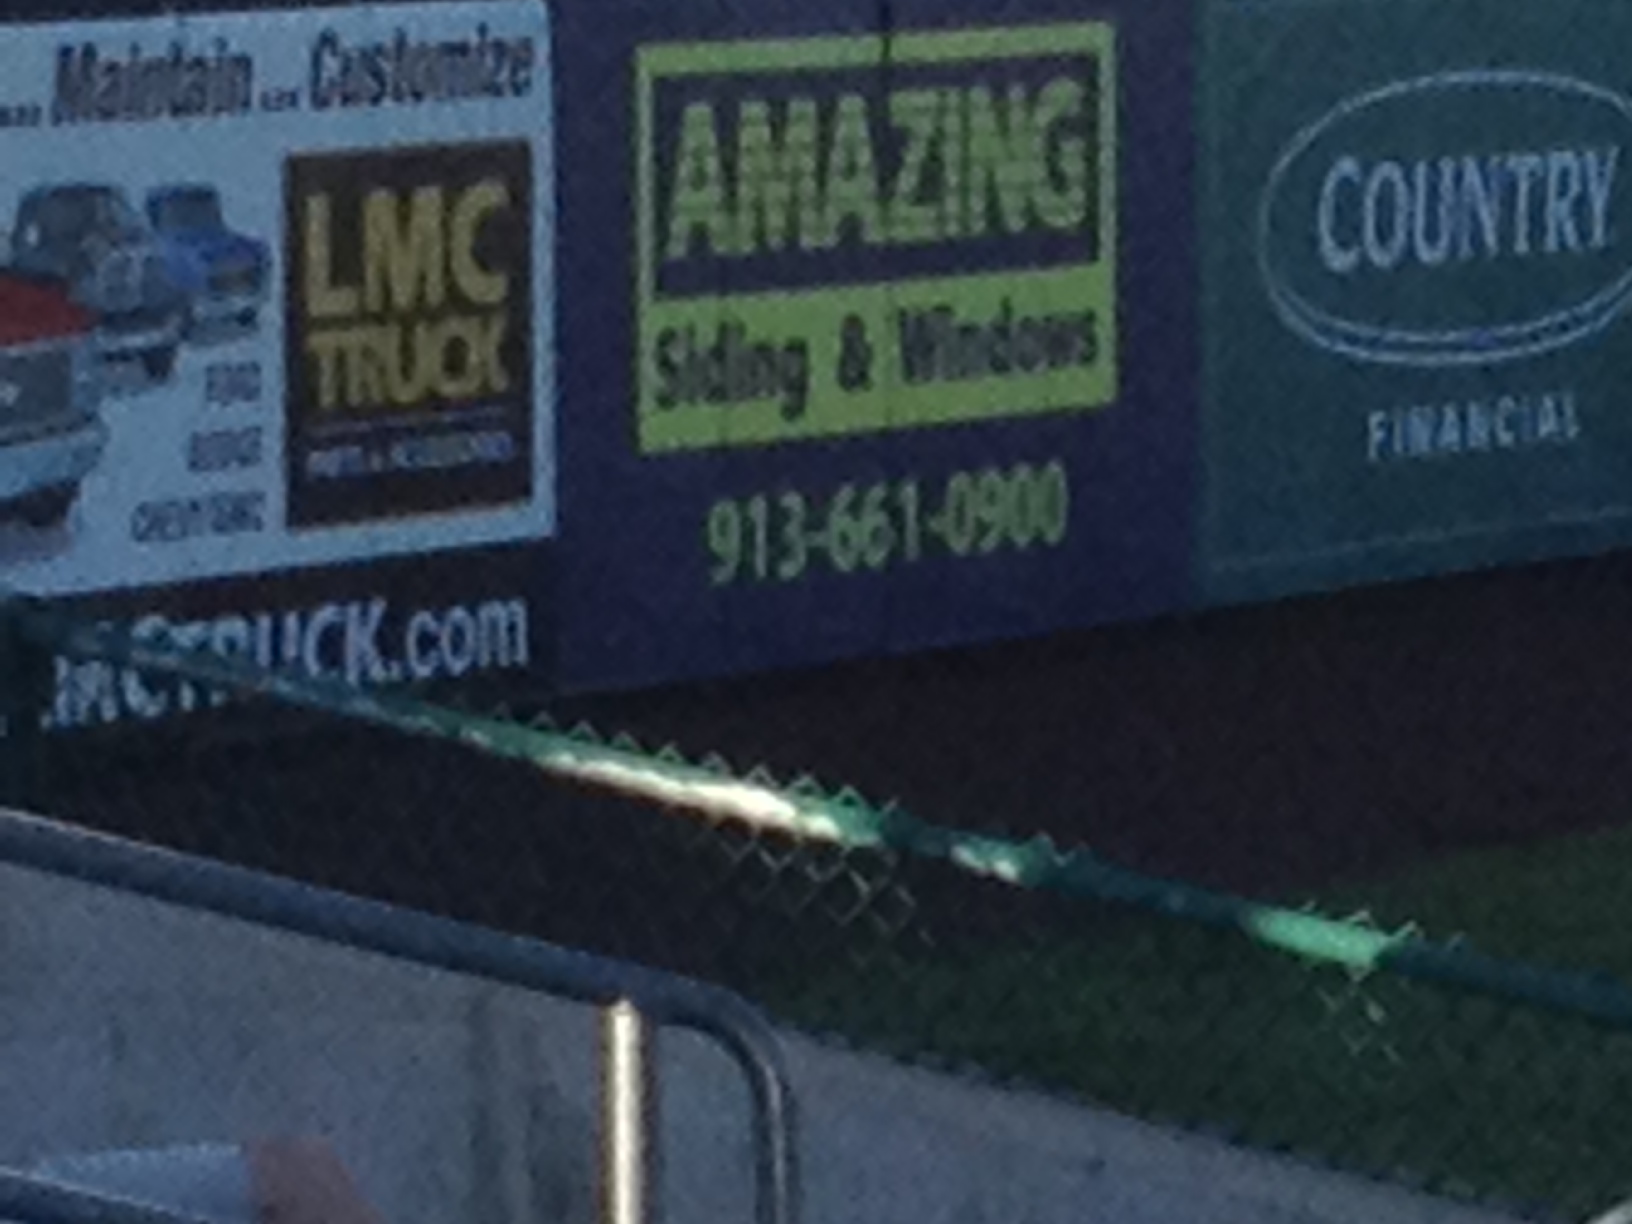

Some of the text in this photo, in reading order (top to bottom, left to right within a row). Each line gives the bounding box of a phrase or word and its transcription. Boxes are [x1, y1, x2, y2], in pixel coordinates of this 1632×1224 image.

[50, 22, 535, 127] Maintain Customize
[667, 77, 1086, 258] AMAZING
[1318, 145, 1620, 271] COUNTRY
[306, 177, 510, 318] LMC
[306, 307, 510, 410] TRUCK
[656, 298, 1097, 422] Siding & Windows
[1368, 392, 1582, 463] FINANCIAL
[705, 458, 1068, 587] 913-661-0900
